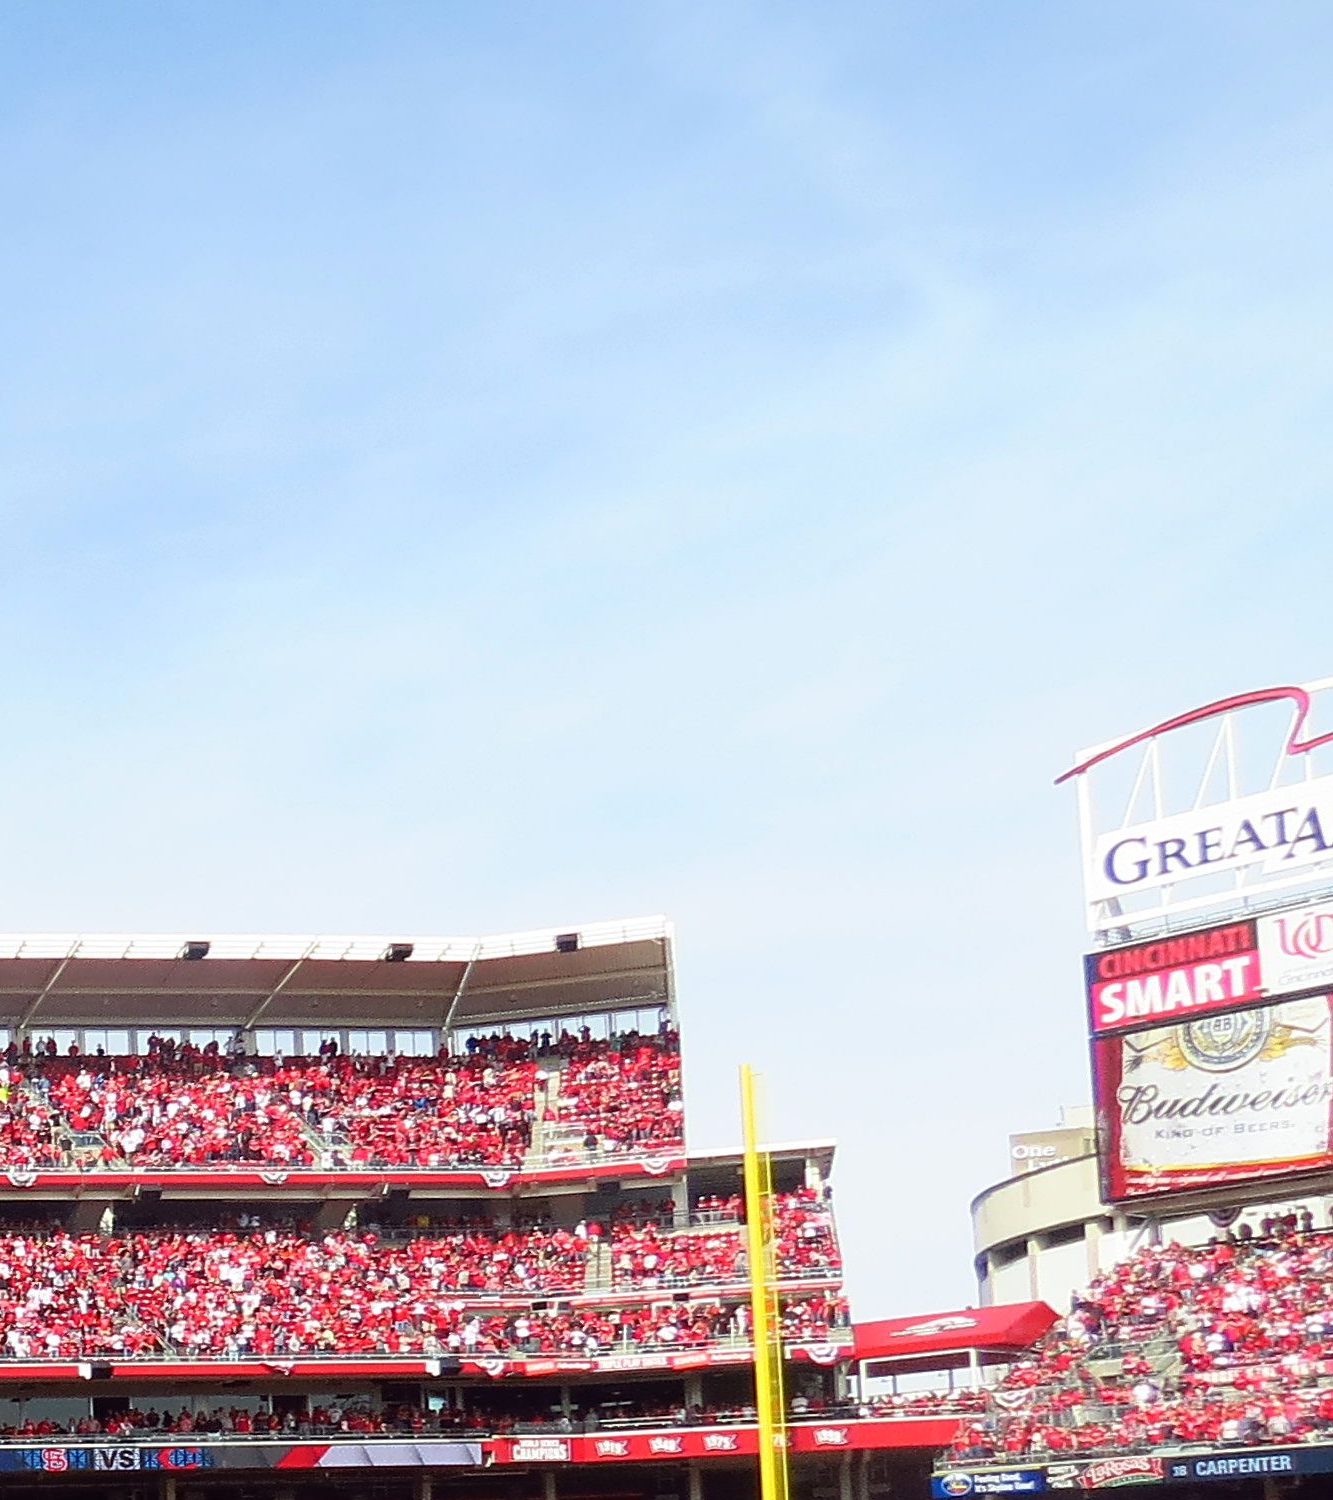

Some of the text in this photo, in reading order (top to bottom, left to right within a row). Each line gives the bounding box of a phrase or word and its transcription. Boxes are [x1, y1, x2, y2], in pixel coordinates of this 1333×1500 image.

[1097, 922, 1252, 979] CINCINNATI
[1099, 955, 1251, 1024] SMART
[1012, 1145, 1057, 1160] One
[100, 1450, 136, 1469] VS
[513, 1445, 567, 1461] CHAMPIONS
[1195, 1455, 1293, 1476] CARPENTER
